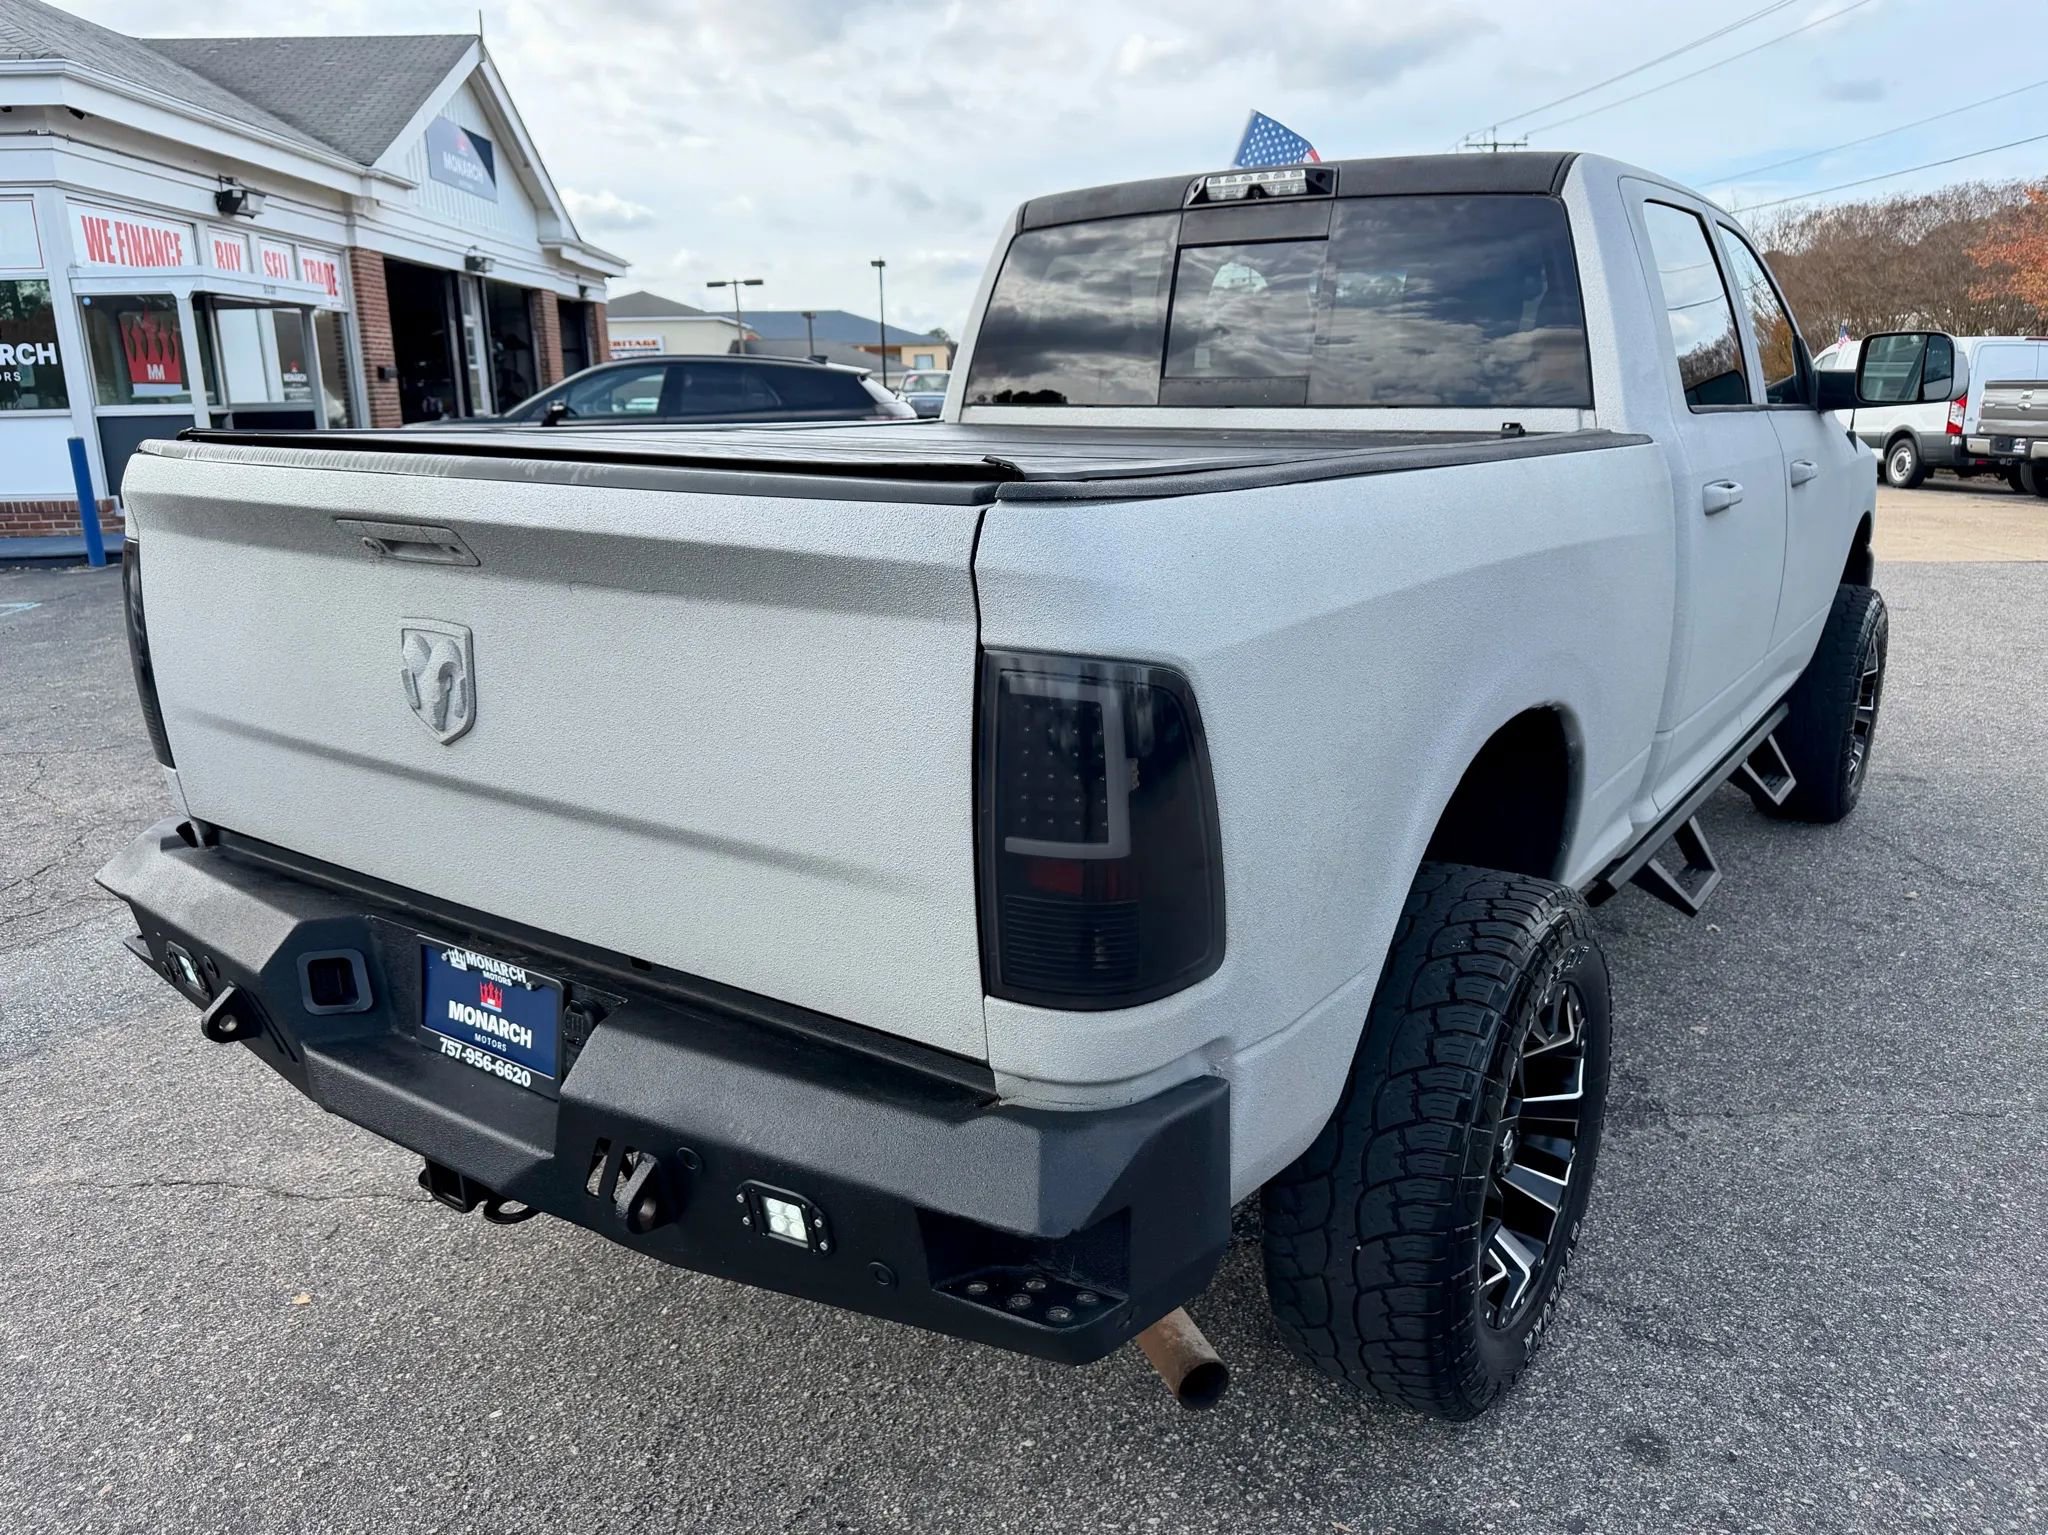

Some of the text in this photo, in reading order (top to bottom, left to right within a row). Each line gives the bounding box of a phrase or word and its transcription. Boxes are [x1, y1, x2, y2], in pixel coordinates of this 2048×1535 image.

[81, 215, 183, 267] WE FINANCE
[303, 258, 338, 296] TRADE
[0, 371, 22, 382] RS
[465, 951, 527, 983] MONARCH
[482, 970, 513, 986] MOTORS
[448, 1000, 533, 1049] MONARCH
[474, 1033, 507, 1052] MOTORS
[439, 1037, 531, 1088] 757-956-6620
